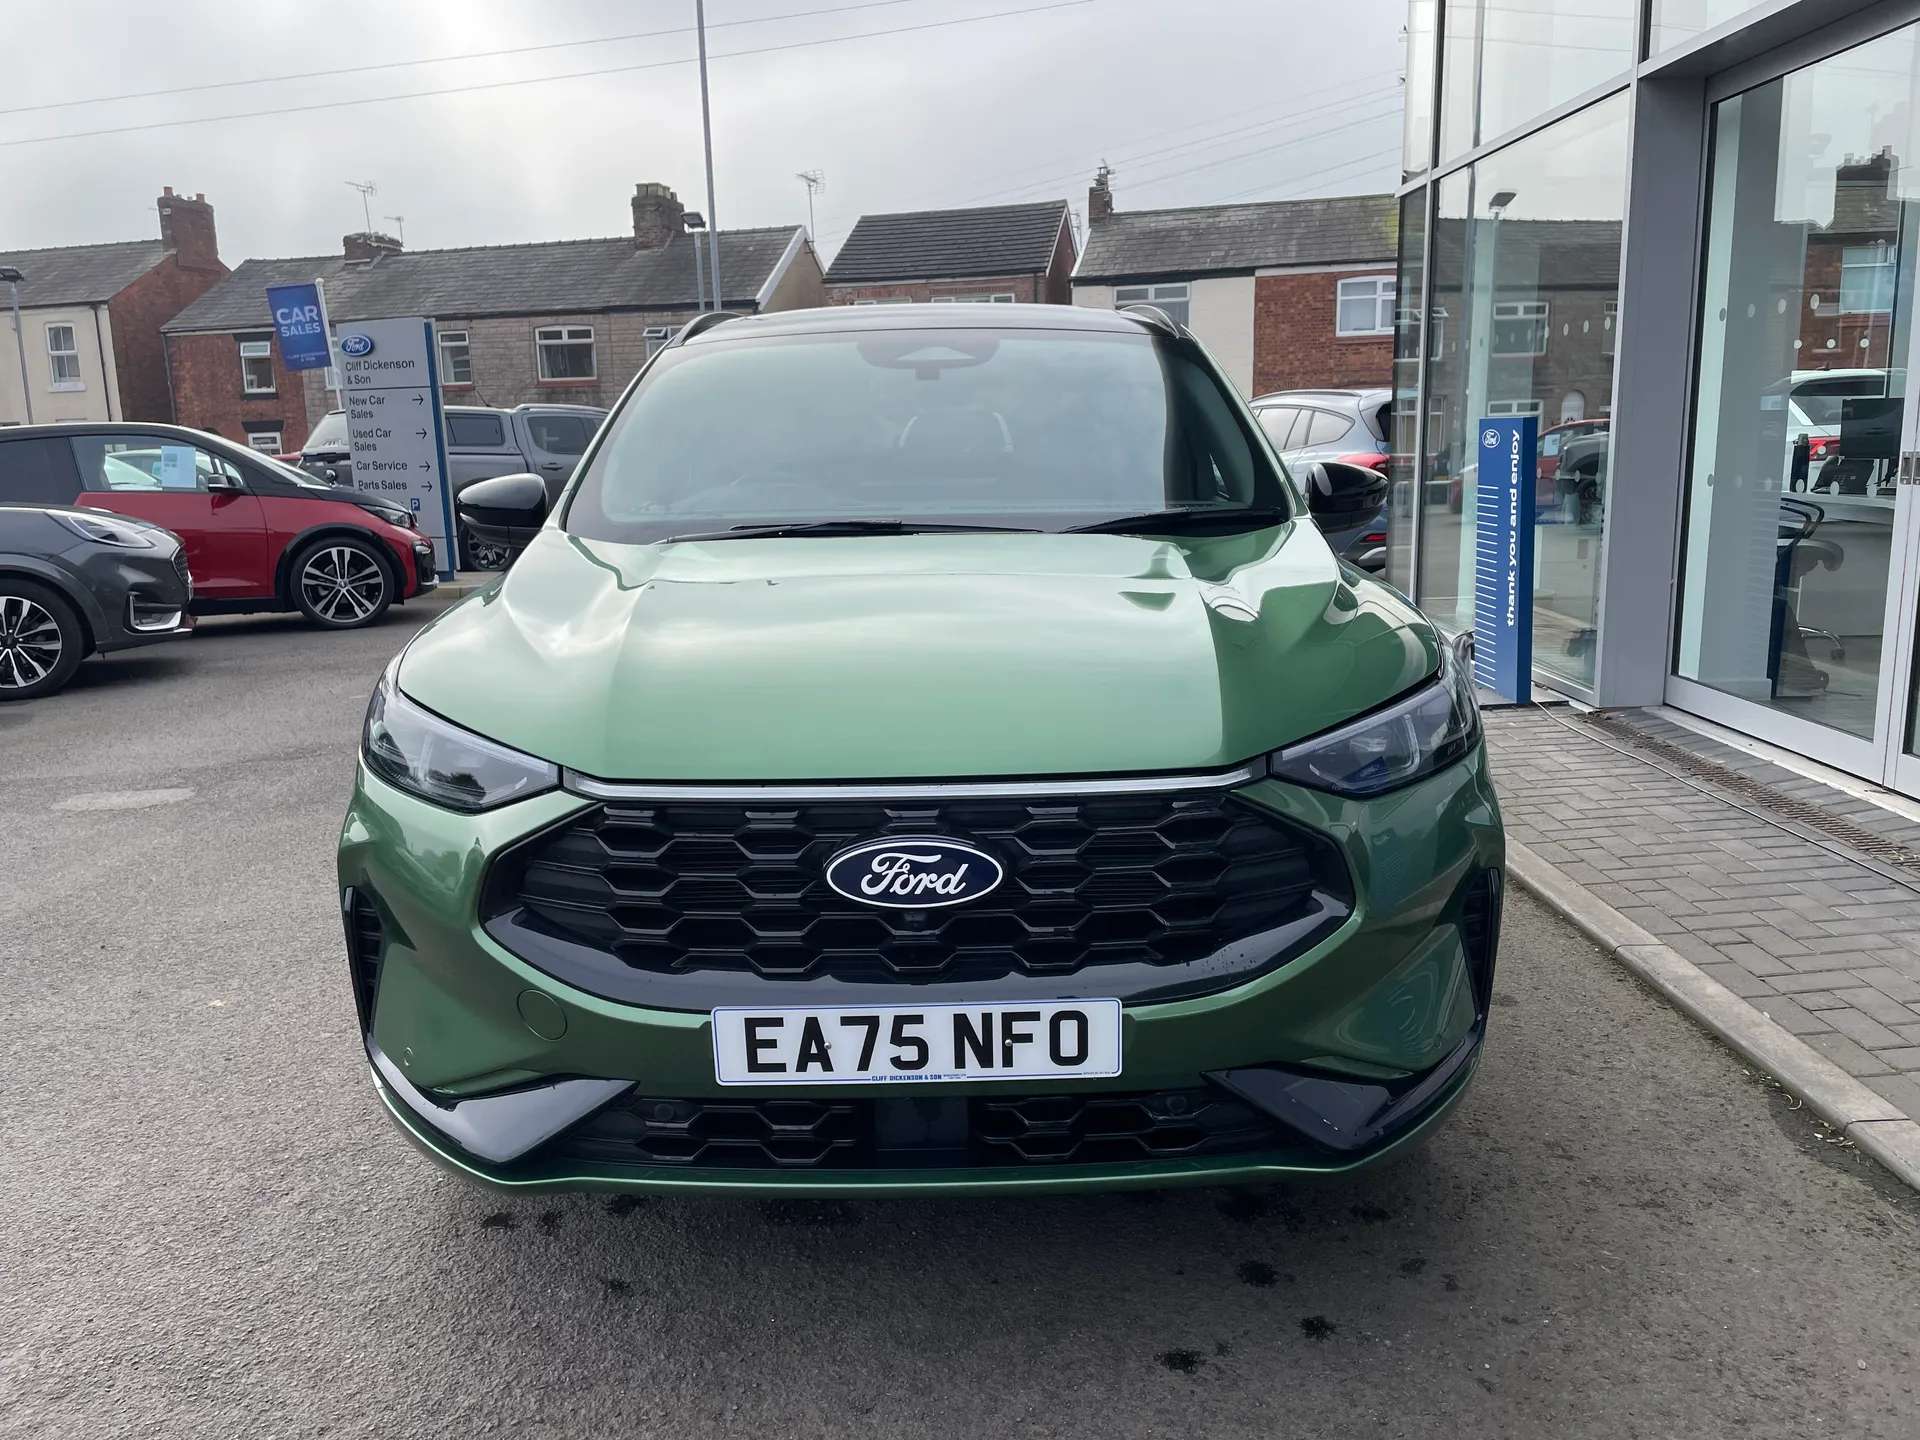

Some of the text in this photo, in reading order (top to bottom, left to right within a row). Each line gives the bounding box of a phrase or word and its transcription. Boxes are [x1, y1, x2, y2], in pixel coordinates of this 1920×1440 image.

[277, 305, 319, 324] CAR
[281, 322, 321, 337] SALES
[345, 338, 365, 352] Ford
[346, 360, 415, 371] Cliff Dickenson
[347, 374, 371, 385] & Son
[349, 395, 385, 406] New Car
[350, 409, 374, 419] Sales
[352, 428, 392, 439] Used Car
[1484, 431, 1498, 445] Ford
[354, 441, 377, 452] Sales
[356, 460, 408, 471] Car Service
[358, 480, 407, 491] Parts Sales
[1507, 429, 1520, 627] thank you and enjoy
[860, 852, 969, 896] Ford
[743, 1010, 1089, 1073] EA75 NFO
